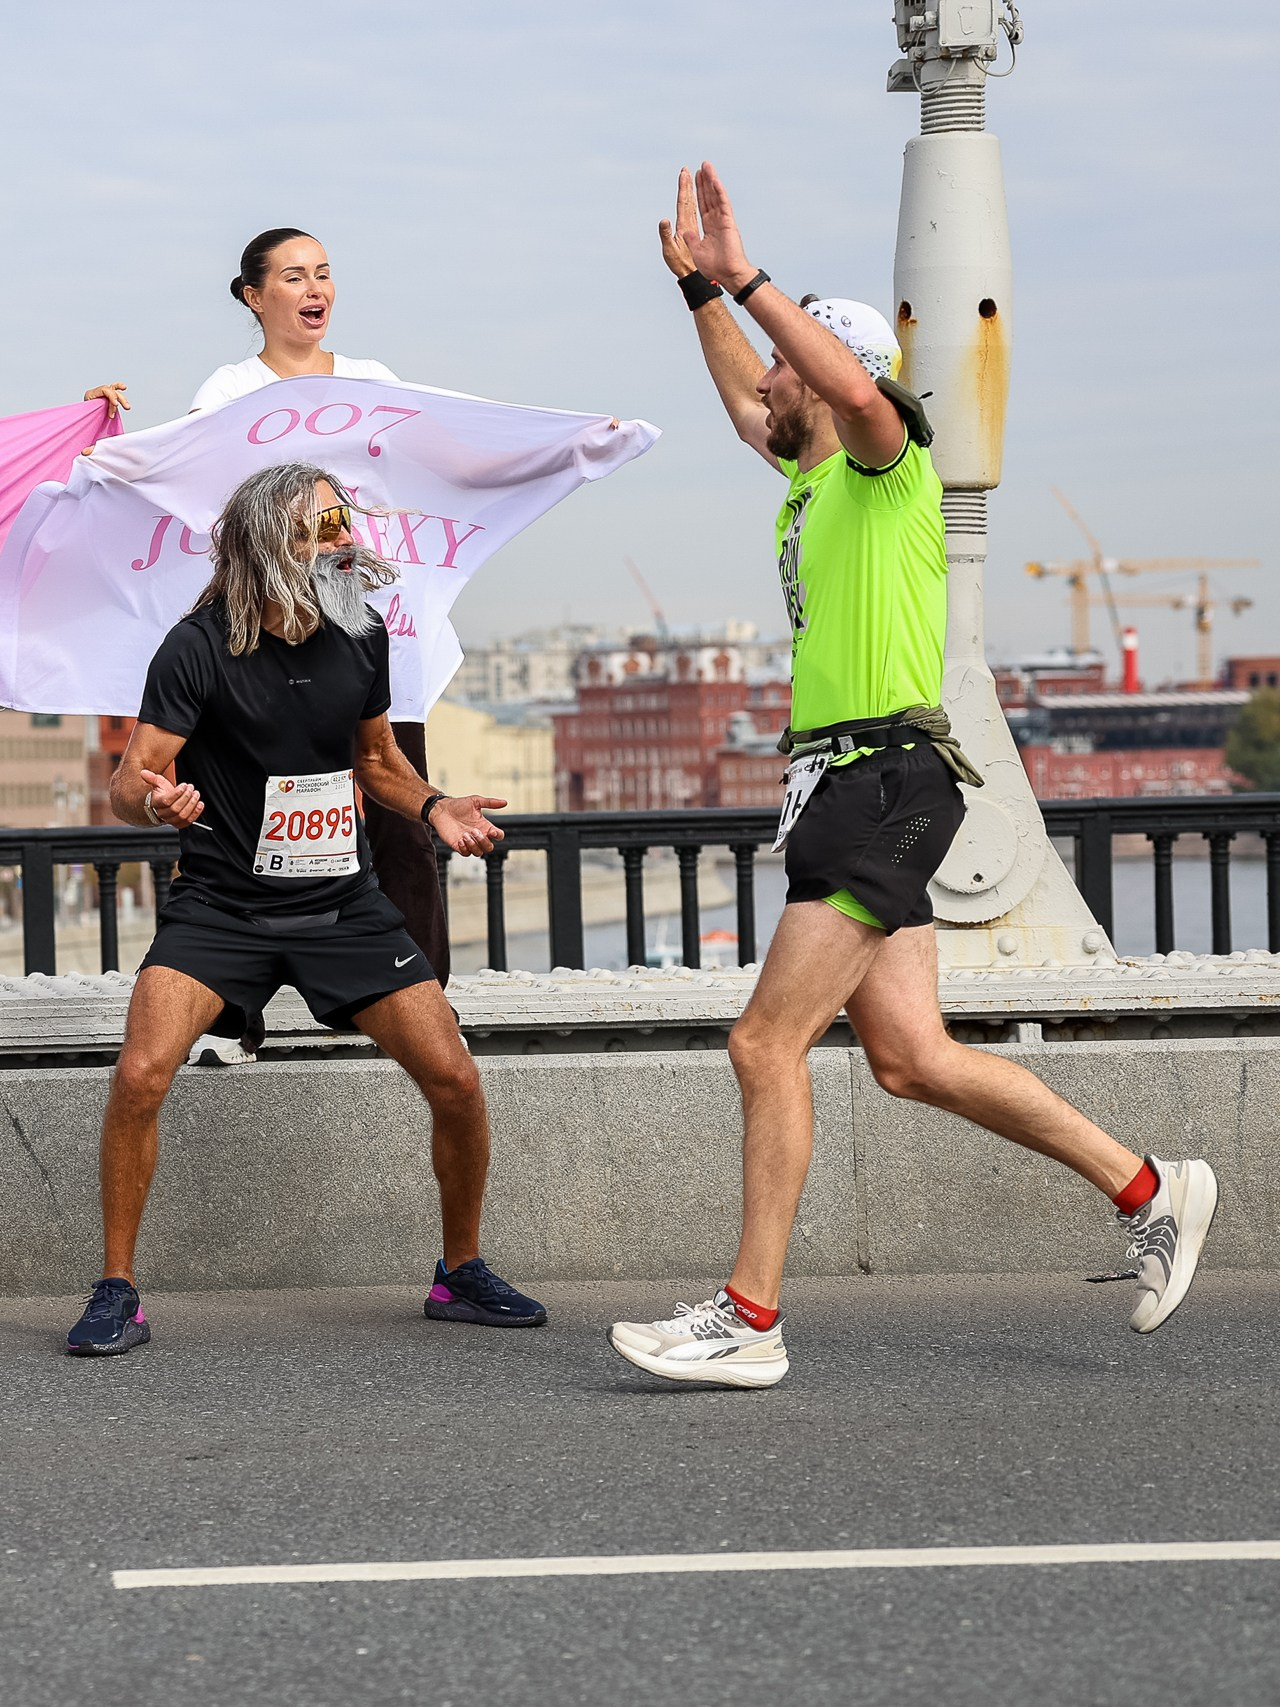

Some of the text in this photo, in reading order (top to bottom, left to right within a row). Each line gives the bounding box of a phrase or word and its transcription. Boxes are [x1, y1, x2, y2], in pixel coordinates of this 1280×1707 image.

[246, 402, 422, 458] 007
[130, 514, 212, 572] JU
[264, 804, 353, 842] 20895
[269, 854, 285, 871] B
